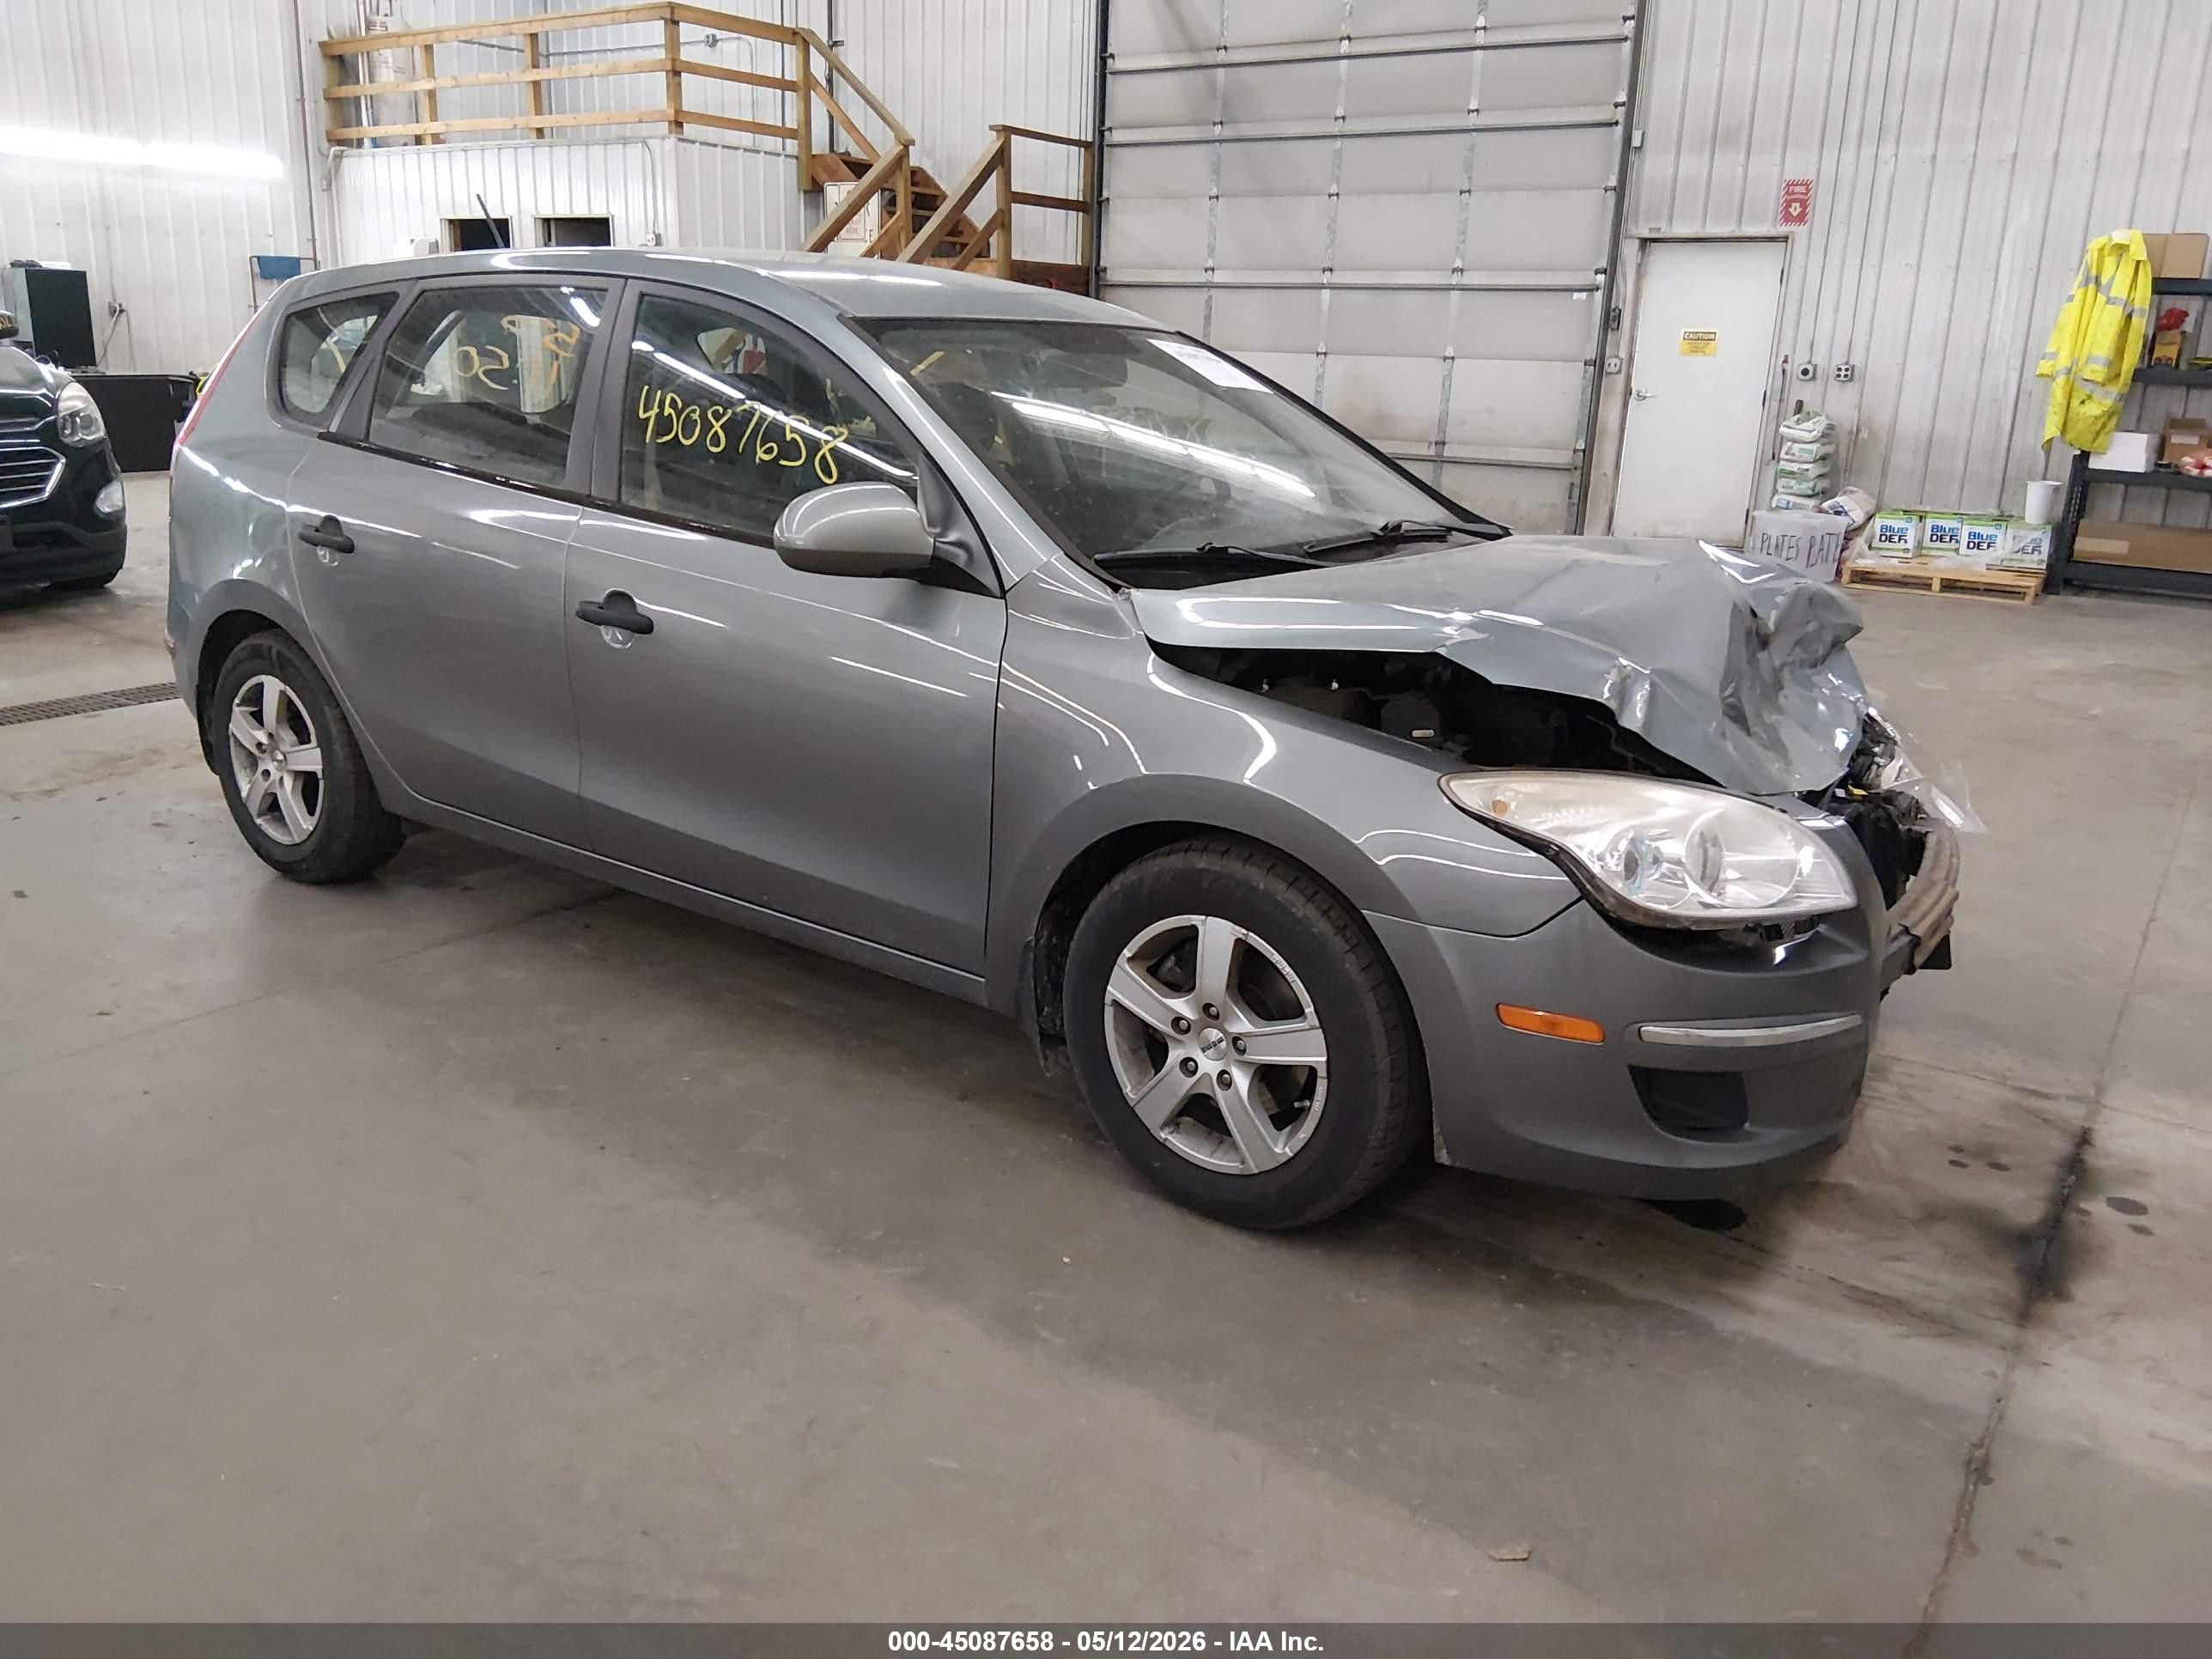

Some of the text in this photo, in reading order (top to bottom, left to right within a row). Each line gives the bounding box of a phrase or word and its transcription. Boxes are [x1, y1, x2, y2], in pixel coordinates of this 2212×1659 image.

[1684, 332, 1716, 341] CAUTION
[638, 385, 849, 484] 45087658
[1880, 524, 1909, 534] Blue
[1930, 524, 1960, 534] Blue
[1878, 533, 1908, 544] DEF
[1967, 531, 1998, 542] Blue
[1760, 532, 1802, 562] PLATES
[1966, 540, 1997, 551] DEF
